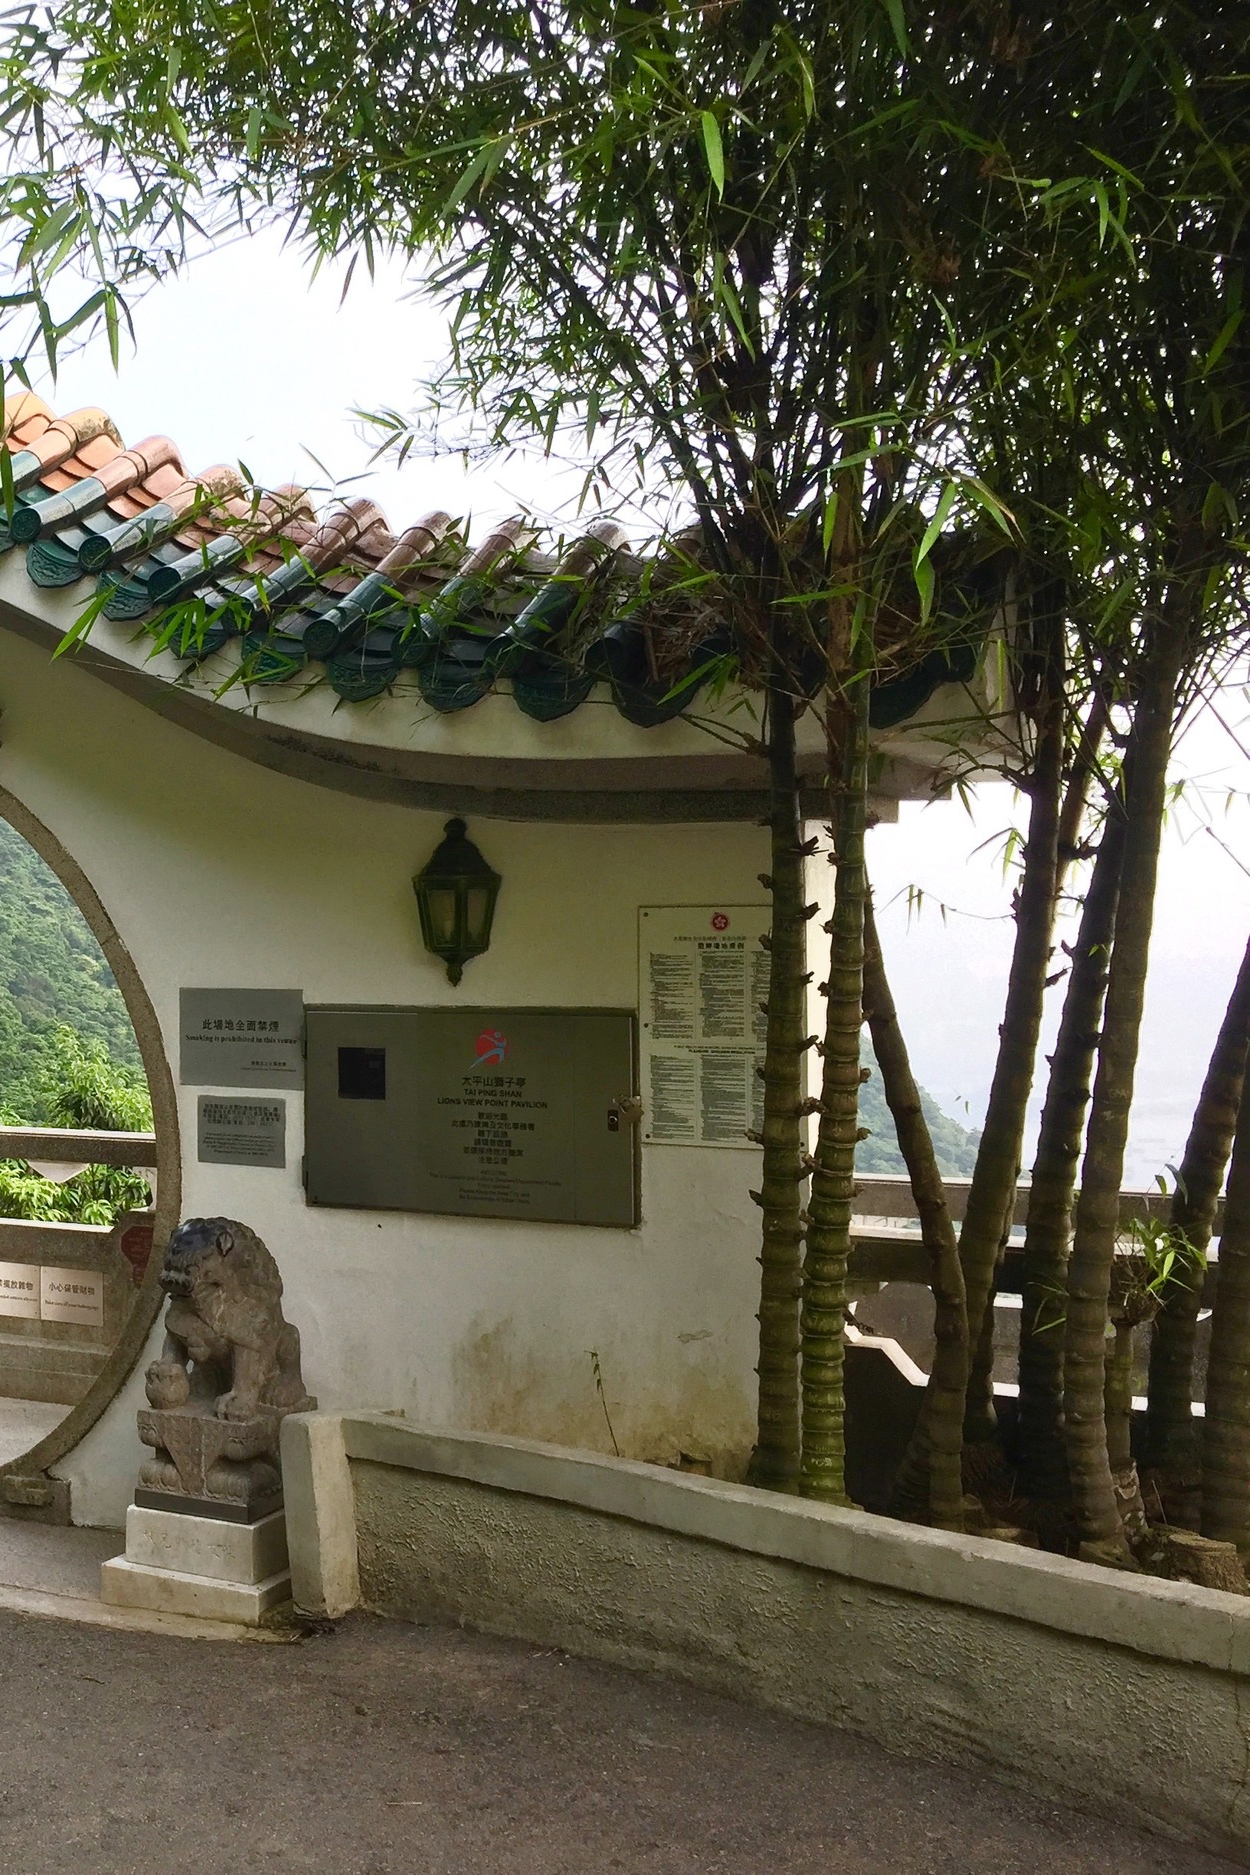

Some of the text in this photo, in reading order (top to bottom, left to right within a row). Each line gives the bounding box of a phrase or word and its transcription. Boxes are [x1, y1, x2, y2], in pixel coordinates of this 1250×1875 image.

[202, 1019, 280, 1032] 此場地全面禁煙
[185, 1034, 213, 1043] Smoking
[464, 1088, 476, 1096] TAI
[499, 1090, 522, 1098] SHAN
[463, 1098, 484, 1106] VIEW
[485, 1099, 509, 1107] POINT
[511, 1100, 548, 1109] PAVILION
